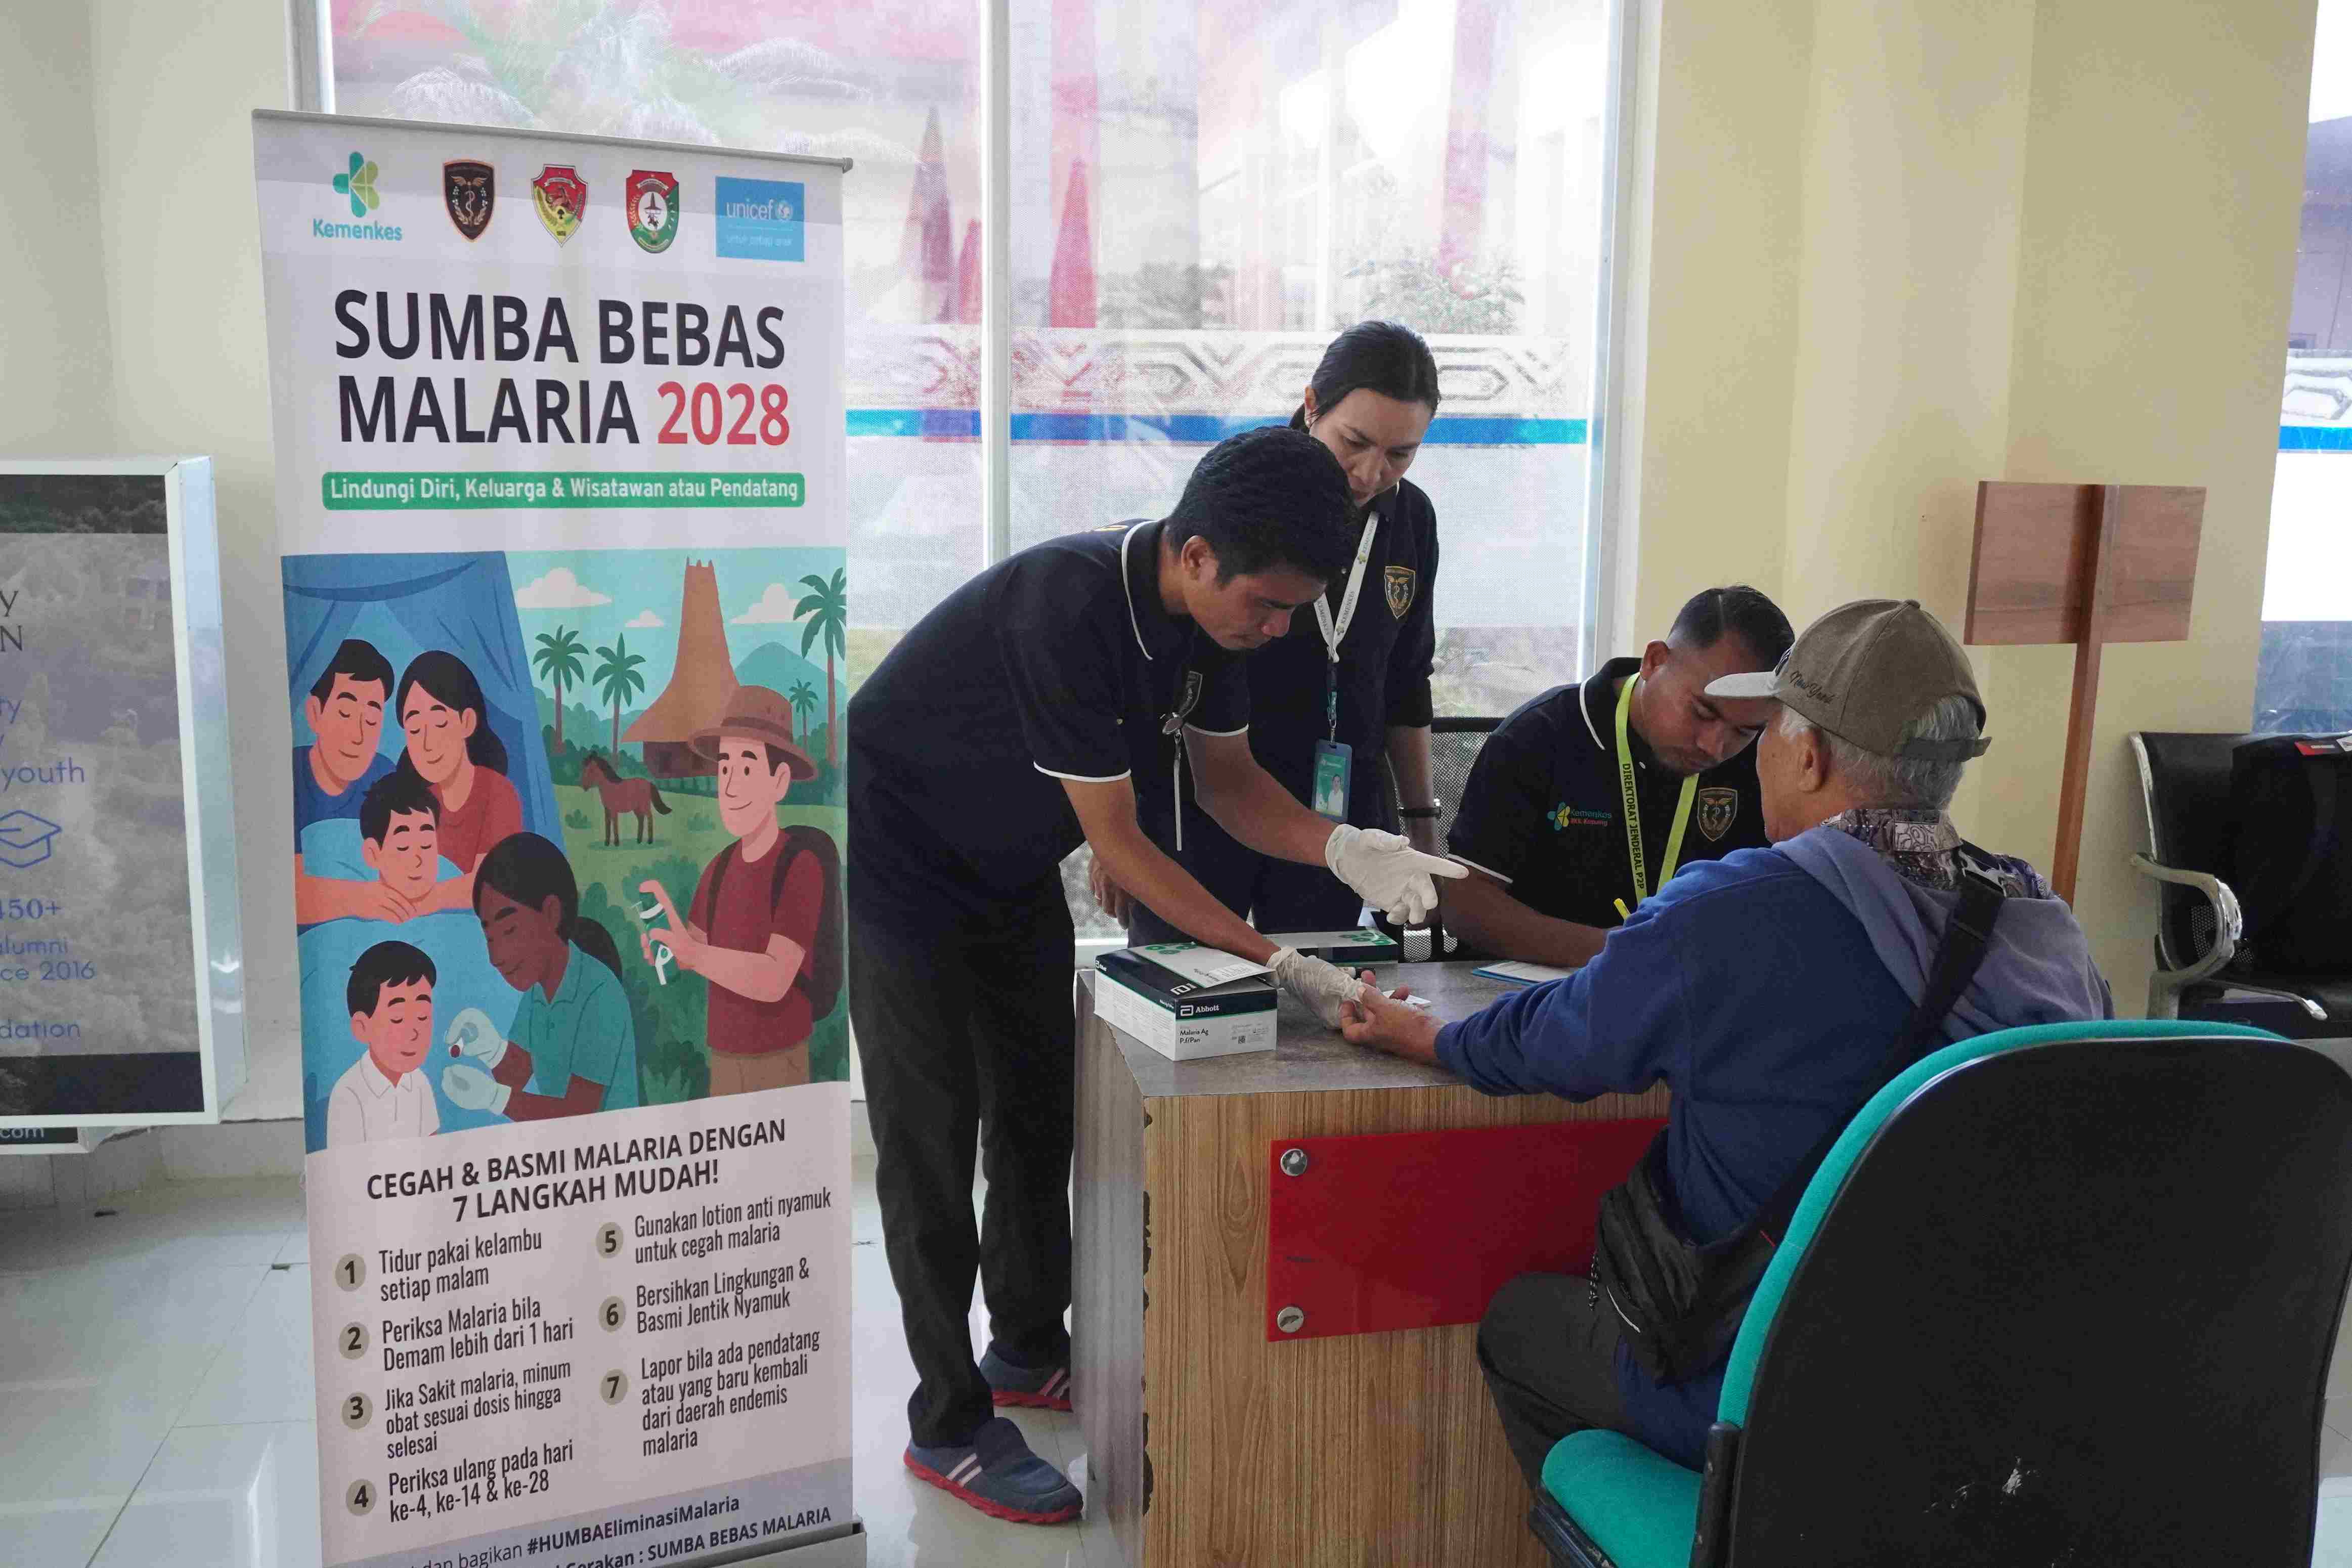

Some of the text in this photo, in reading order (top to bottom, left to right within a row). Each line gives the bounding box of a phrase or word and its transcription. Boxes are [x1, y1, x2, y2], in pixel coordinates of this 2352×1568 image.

[314, 219, 402, 242] Kemenkes
[726, 198, 775, 220] unicef
[335, 290, 784, 369] SUMBA BEBAS
[339, 376, 789, 445] MALARIA 2028
[331, 478, 797, 503] Lindungi Diri, Keluarga & Wisatawan atau Pendatang
[1340, 591, 1355, 624] KEMENKES
[1, 757, 84, 791] youth
[1623, 763, 1644, 889] DIREKTORAT JENDERAL P2P
[40, 961, 96, 980] 2016
[0, 1019, 80, 1038] dation
[1195, 1005, 1219, 1013] Abbott
[1201, 1028, 1209, 1036] Ag
[368, 1119, 785, 1199] CEGAH & BASMI MALARIA DENGAN
[453, 1159, 718, 1222] 7 LANGKAH MUDAH!
[635, 1187, 831, 1237] Gunakan lotion anti nyamuk
[379, 1228, 541, 1274] Tidur pakai kelambu
[605, 1230, 616, 1253] 5
[636, 1222, 779, 1264] untuk cegah malaria
[345, 1261, 355, 1284] 1
[381, 1266, 489, 1301] setiap malam
[637, 1257, 809, 1310] Bersihkan Lingkungan &
[383, 1296, 540, 1343] Periksa Malaria bila
[606, 1303, 618, 1326] 6
[637, 1287, 790, 1333] Basmi Jentik Nyamuk
[348, 1327, 361, 1351] 2
[384, 1318, 573, 1371] Demam lebih dari 1 hari
[642, 1331, 819, 1381] Lapor bila ada pendatang
[385, 1363, 570, 1411] Jika Sakit malaria, minum
[607, 1376, 619, 1398] 7
[642, 1355, 808, 1405] atau yang baru kembali
[350, 1397, 363, 1419] 3
[387, 1388, 560, 1434] obat sesuai dosis hingga
[643, 1384, 787, 1430] dari daerah endemis
[387, 1431, 437, 1459] selesai
[643, 1428, 697, 1456] malaria
[389, 1439, 572, 1496] Periksa ulang pada hari
[354, 1485, 368, 1507] 4
[390, 1469, 549, 1522] ke-4, ke-14 & ke-28
[459, 1545, 521, 1568] bagikan
[527, 1496, 739, 1555] #HUMBAEliminasiMalaria
[648, 1535, 705, 1561] SUMBA
[710, 1523, 758, 1547] BEBAS
[763, 1507, 831, 1536] MALARIA
